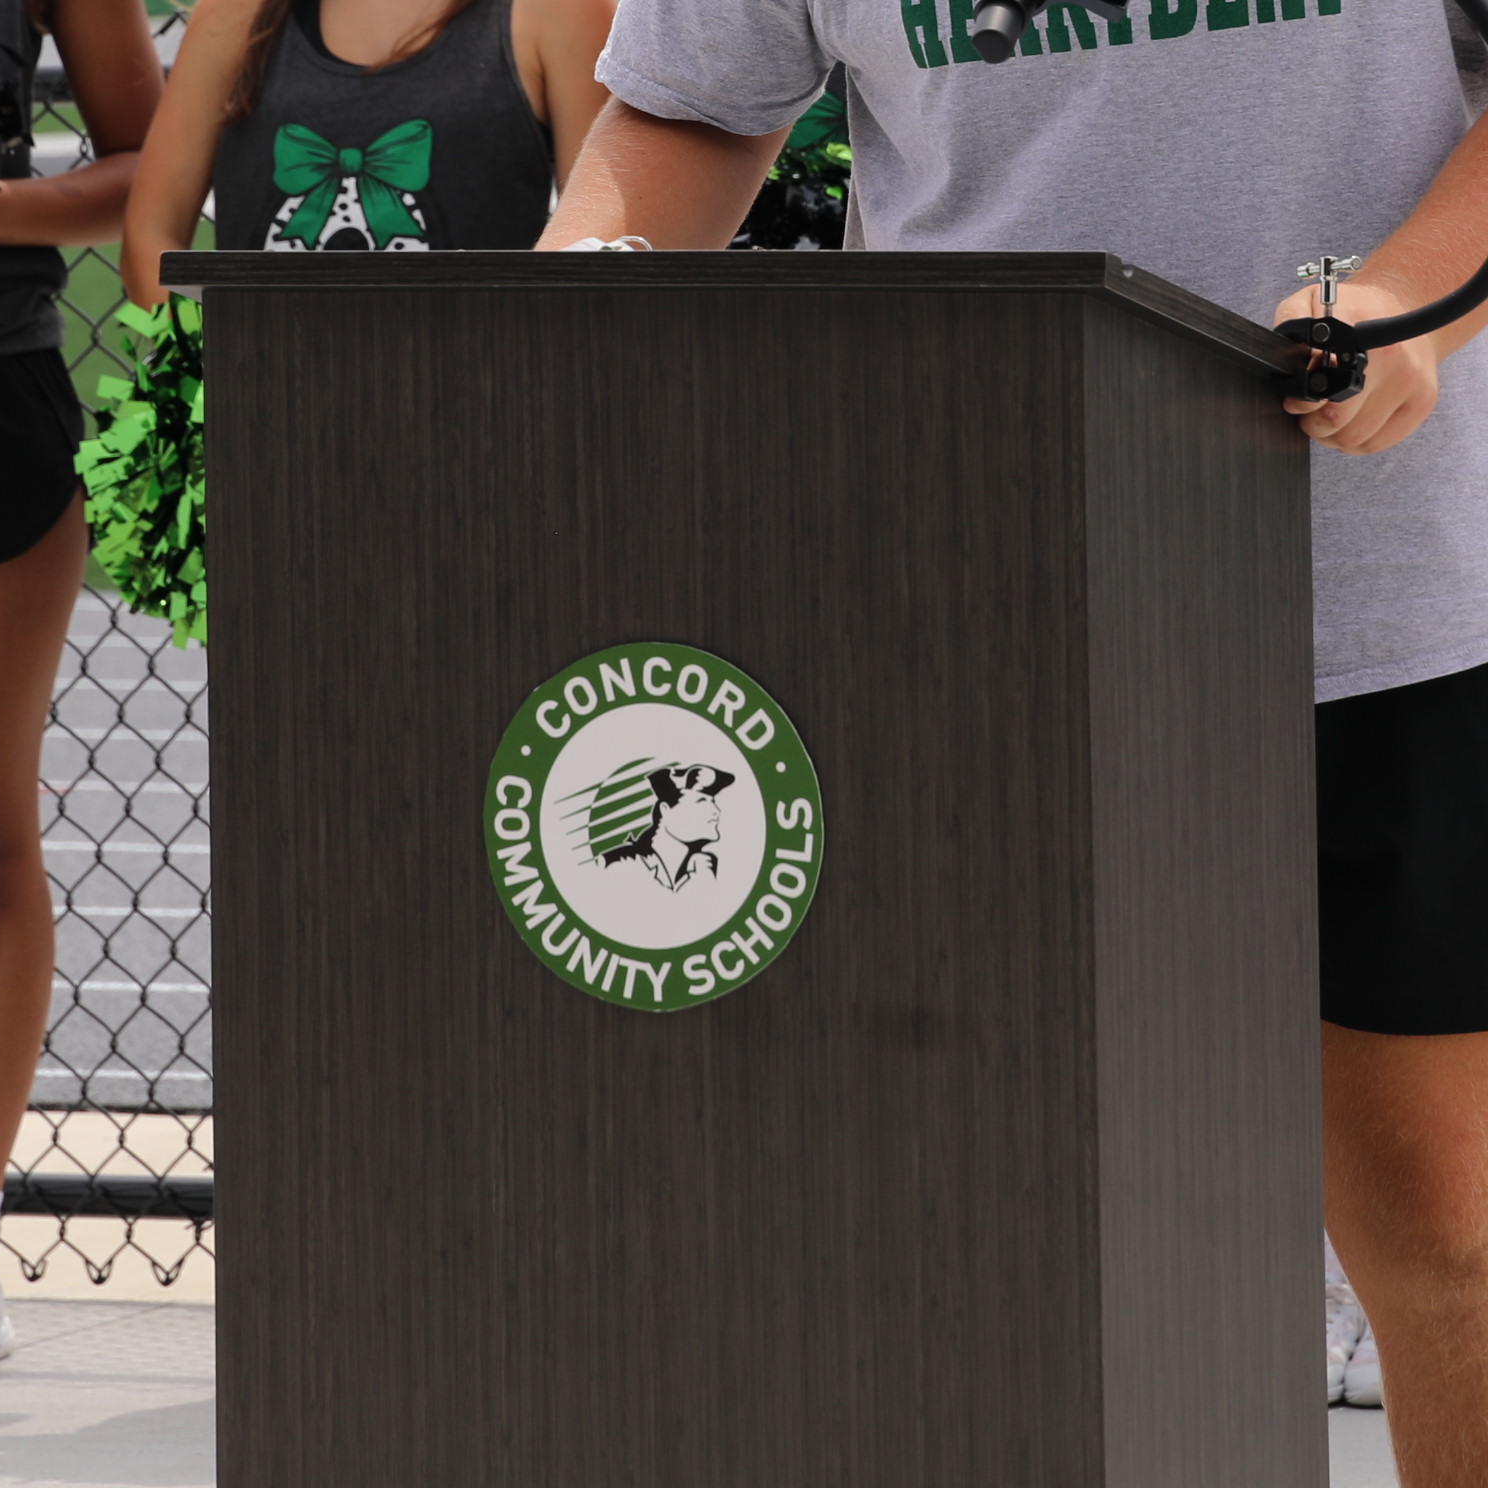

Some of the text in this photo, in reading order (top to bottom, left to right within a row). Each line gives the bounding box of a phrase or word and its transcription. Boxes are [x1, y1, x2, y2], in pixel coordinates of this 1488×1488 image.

[534, 656, 775, 751] CONCORD
[493, 774, 814, 1003] COMMUNITY SCHOOLS
